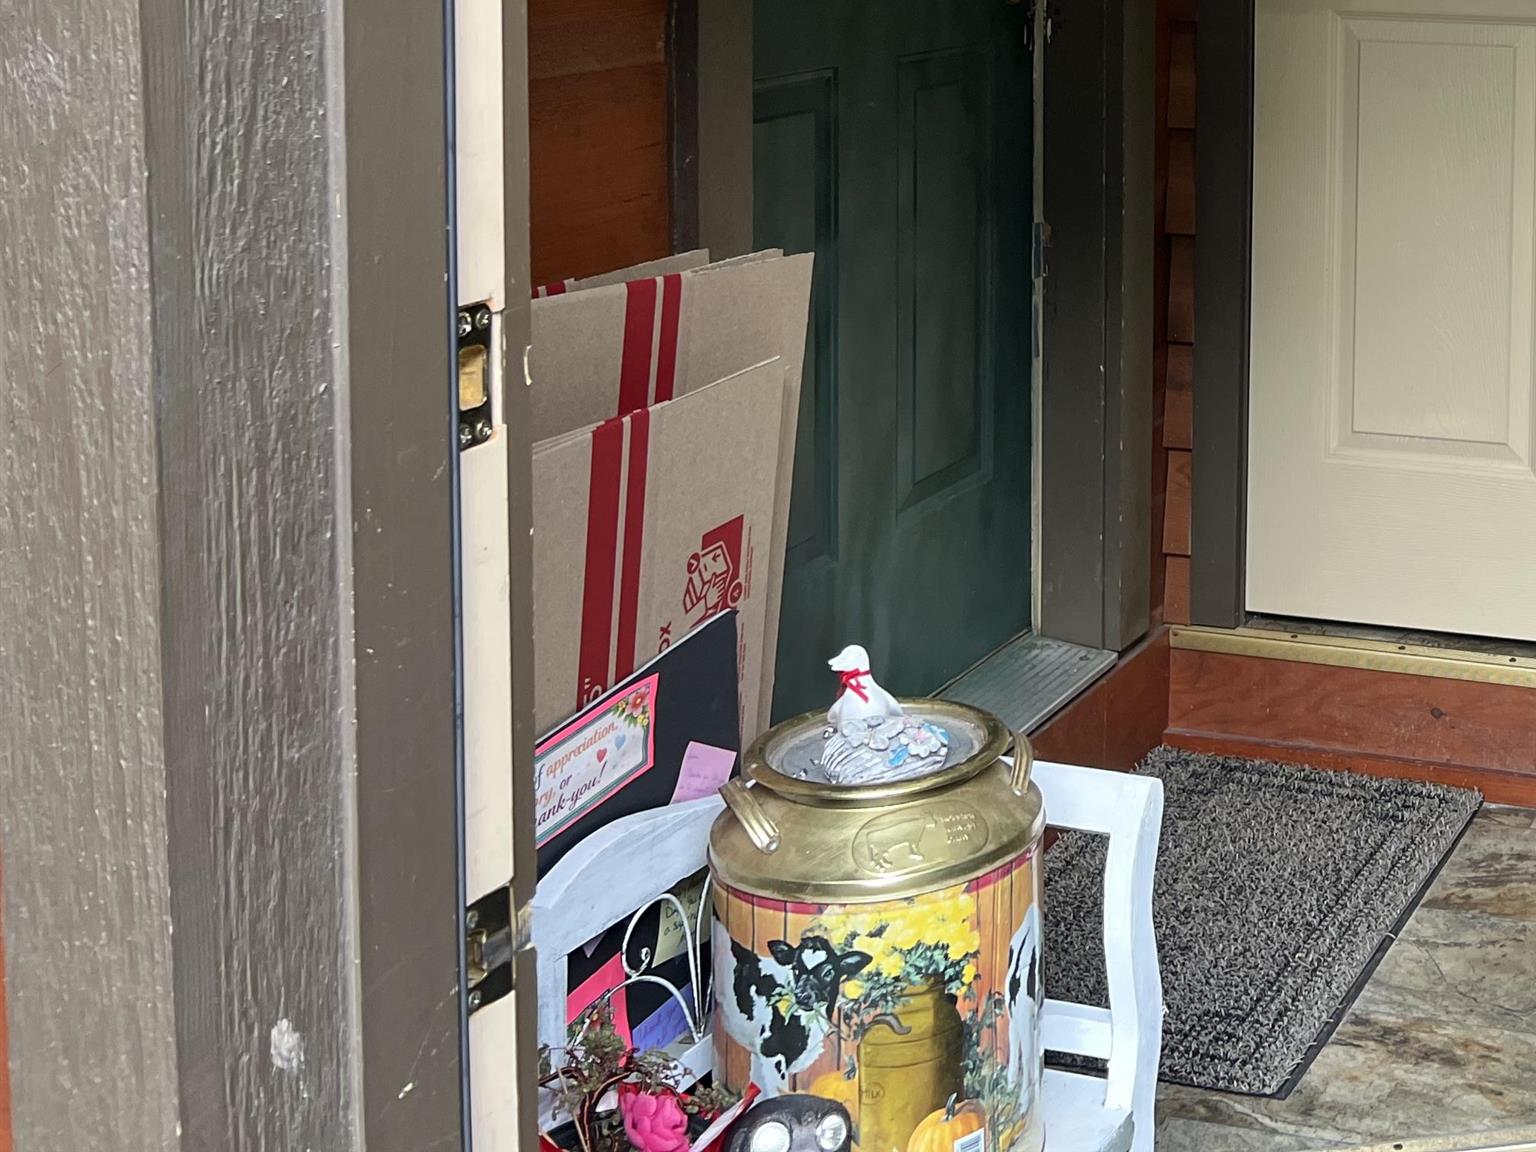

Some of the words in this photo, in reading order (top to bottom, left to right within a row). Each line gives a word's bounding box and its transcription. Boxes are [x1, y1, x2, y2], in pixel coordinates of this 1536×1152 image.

[535, 763, 545, 791] f
[559, 774, 573, 790] or
[535, 760, 608, 826] ank-you!
